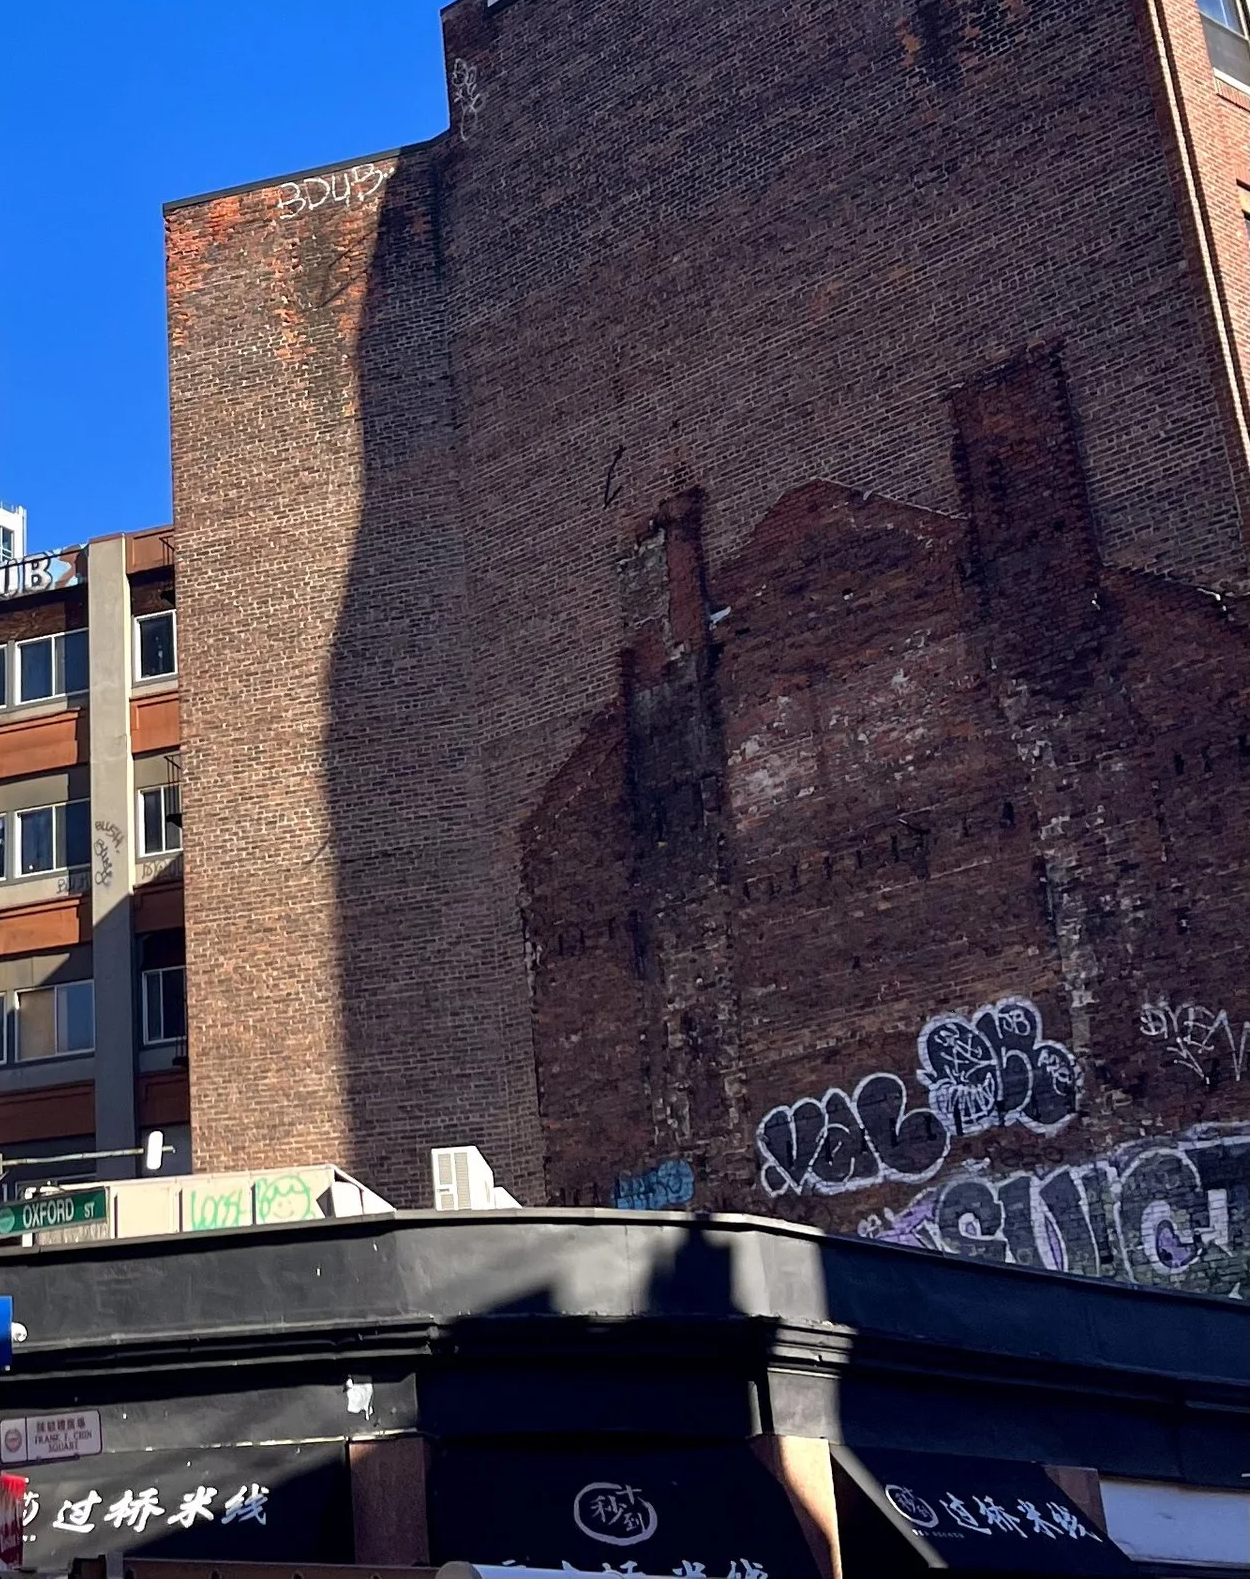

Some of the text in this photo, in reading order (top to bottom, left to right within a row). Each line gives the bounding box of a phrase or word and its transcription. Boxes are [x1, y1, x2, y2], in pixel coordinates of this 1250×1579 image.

[22, 1198, 96, 1229] OXFORD ST
[52, 1483, 270, 1533] 过桥米线
[938, 1491, 1103, 1543] 过桥米线
